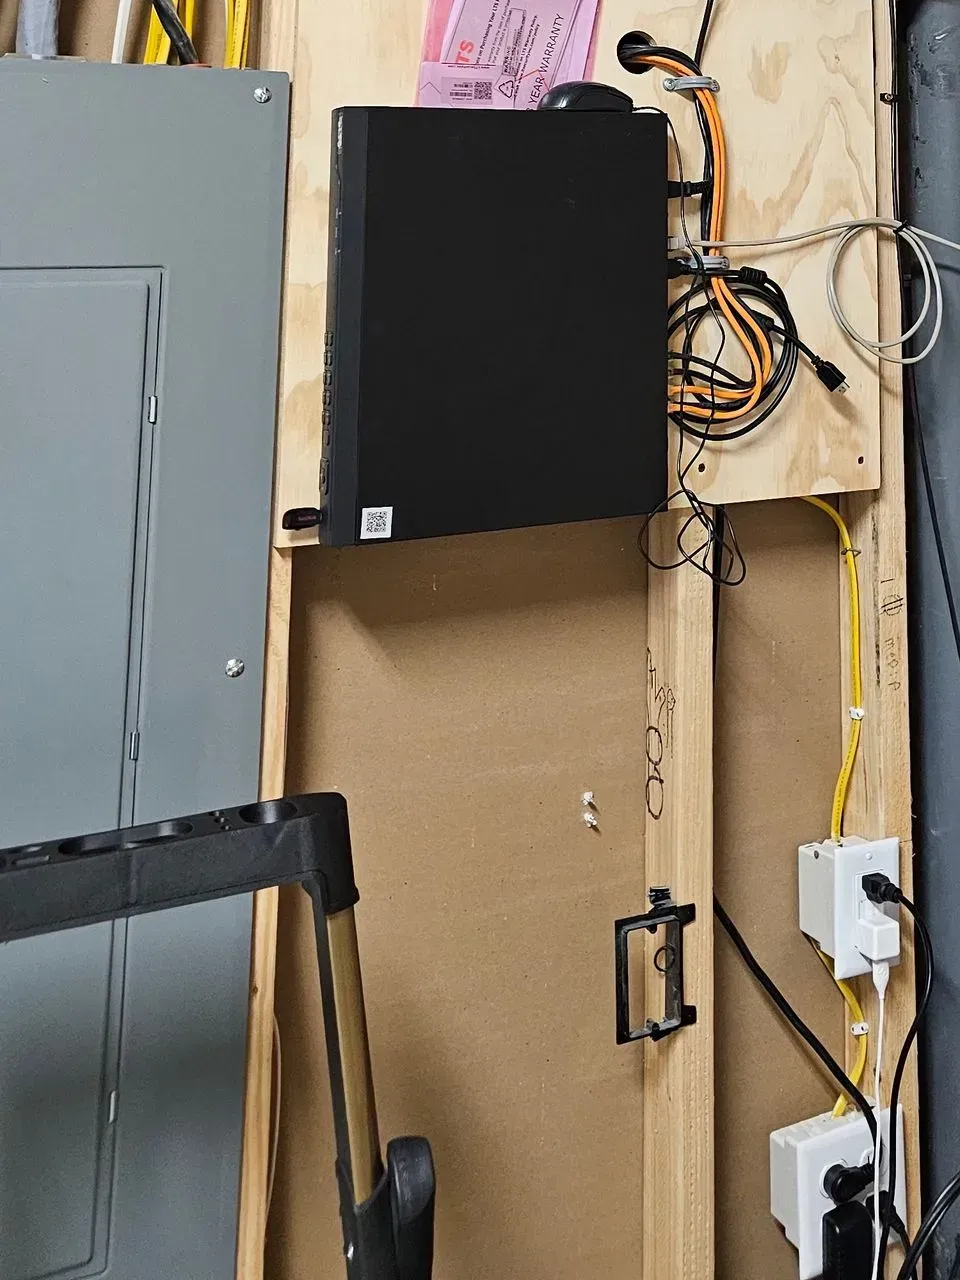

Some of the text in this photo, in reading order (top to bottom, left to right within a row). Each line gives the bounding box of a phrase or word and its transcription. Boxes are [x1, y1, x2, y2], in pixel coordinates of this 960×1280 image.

[480, 23, 493, 49] Purchasing
[455, 39, 476, 64] TS
[528, 13, 564, 104] YEAR WARRANTY
